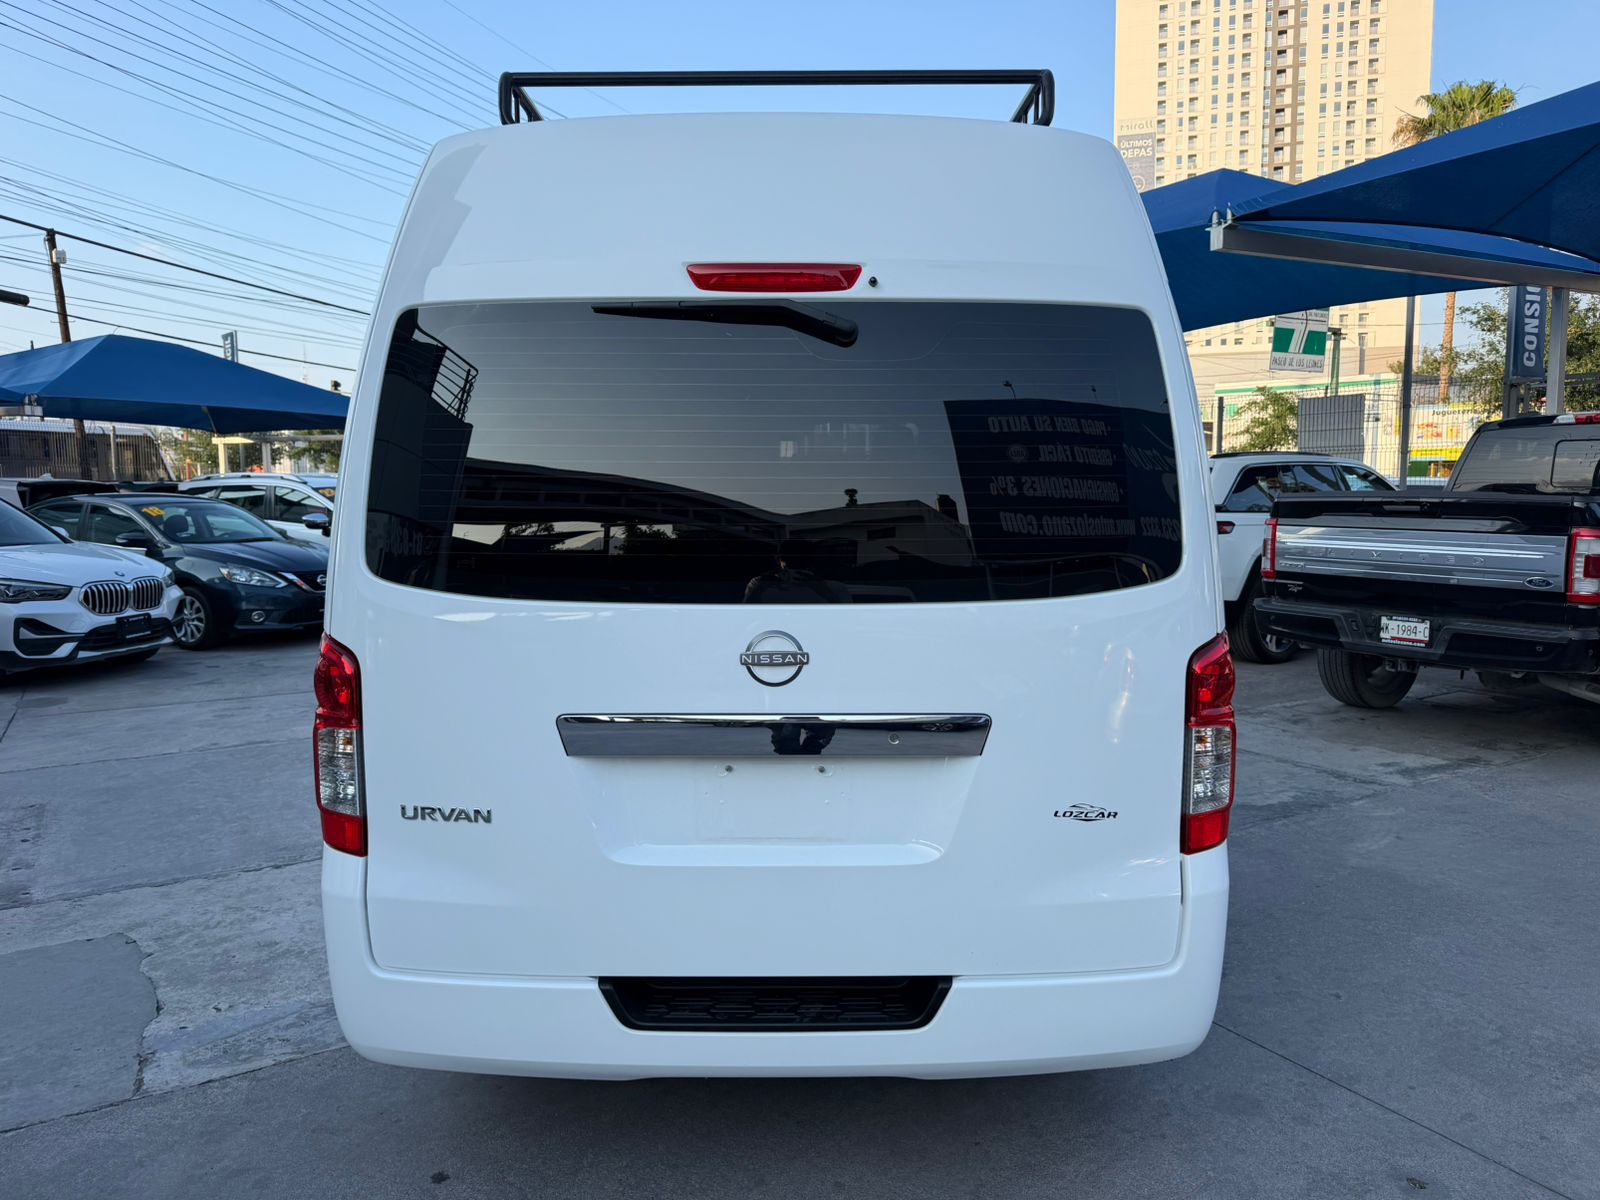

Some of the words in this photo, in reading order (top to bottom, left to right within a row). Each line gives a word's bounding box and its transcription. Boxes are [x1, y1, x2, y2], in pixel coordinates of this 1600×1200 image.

[1120, 138, 1152, 149] ÚLTIMOS
[1120, 147, 1152, 159] DEPAS
[741, 654, 808, 664] NISSAN
[400, 804, 493, 824] URVAN
[1053, 809, 1119, 819] LOZCAR
